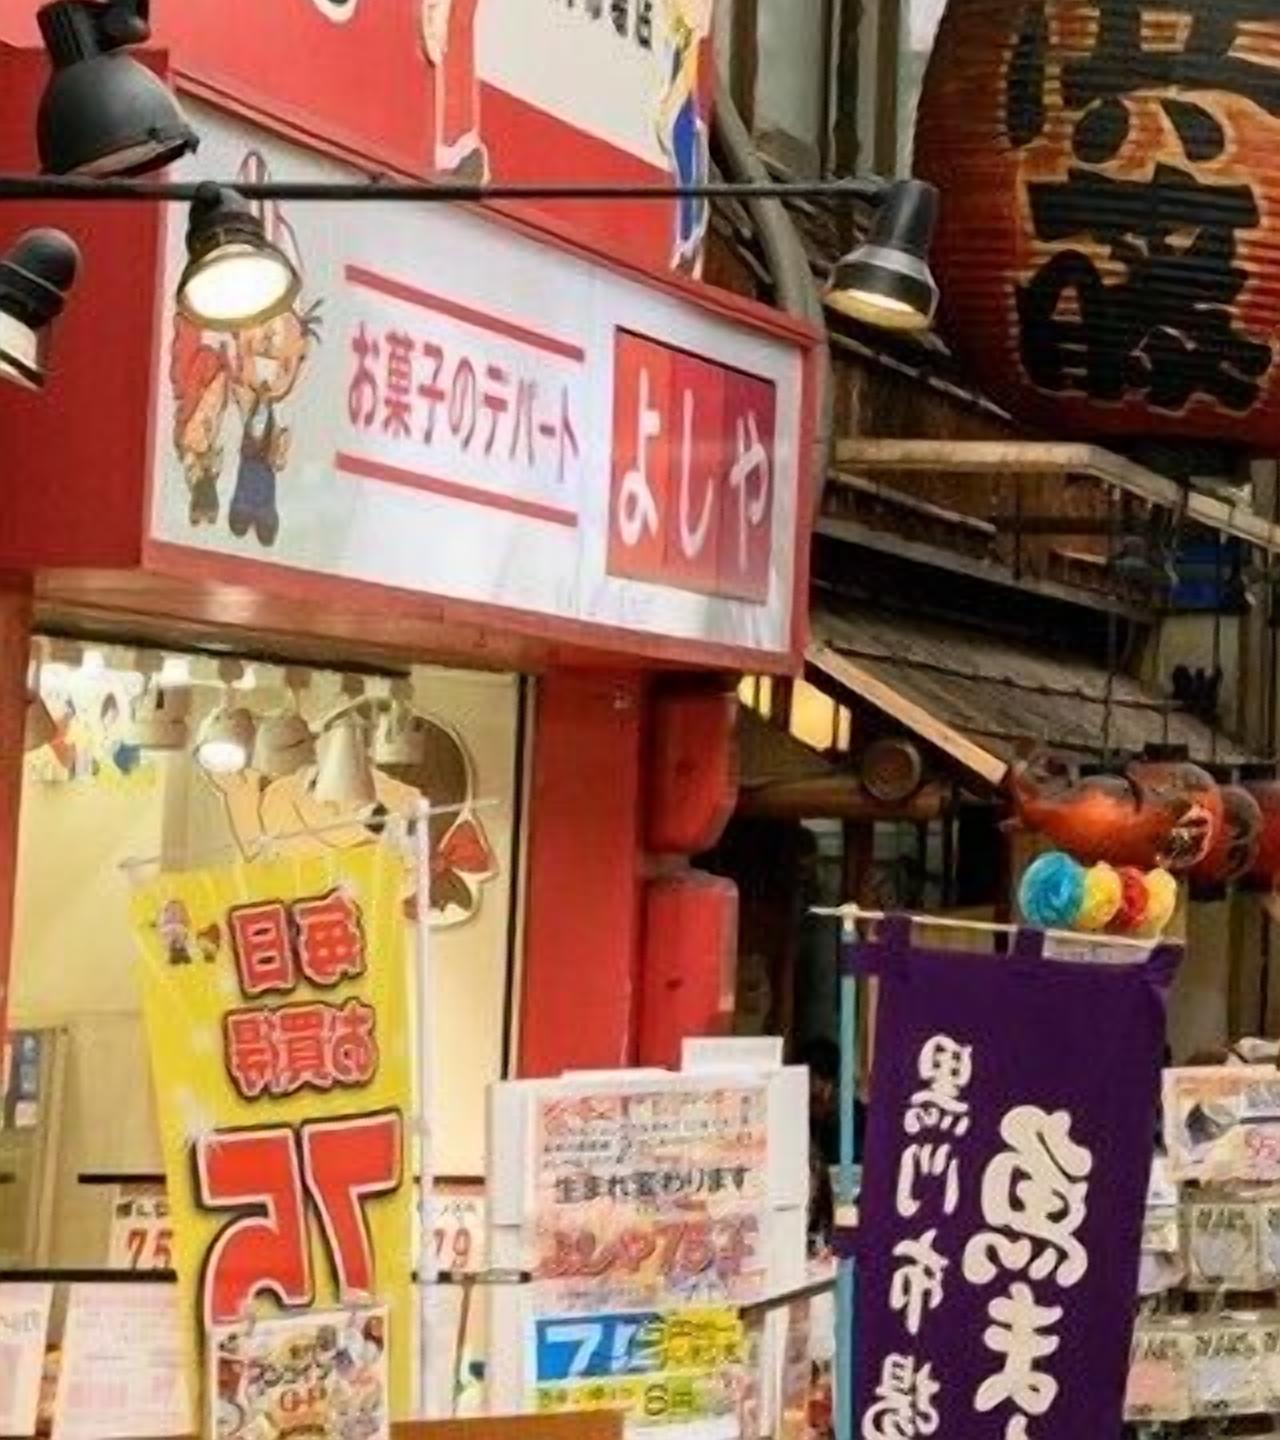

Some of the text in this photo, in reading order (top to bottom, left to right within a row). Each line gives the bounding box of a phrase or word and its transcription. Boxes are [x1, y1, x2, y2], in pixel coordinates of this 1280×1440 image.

[346, 320, 582, 484] お菓子のデパート
[617, 366, 770, 570] よしや
